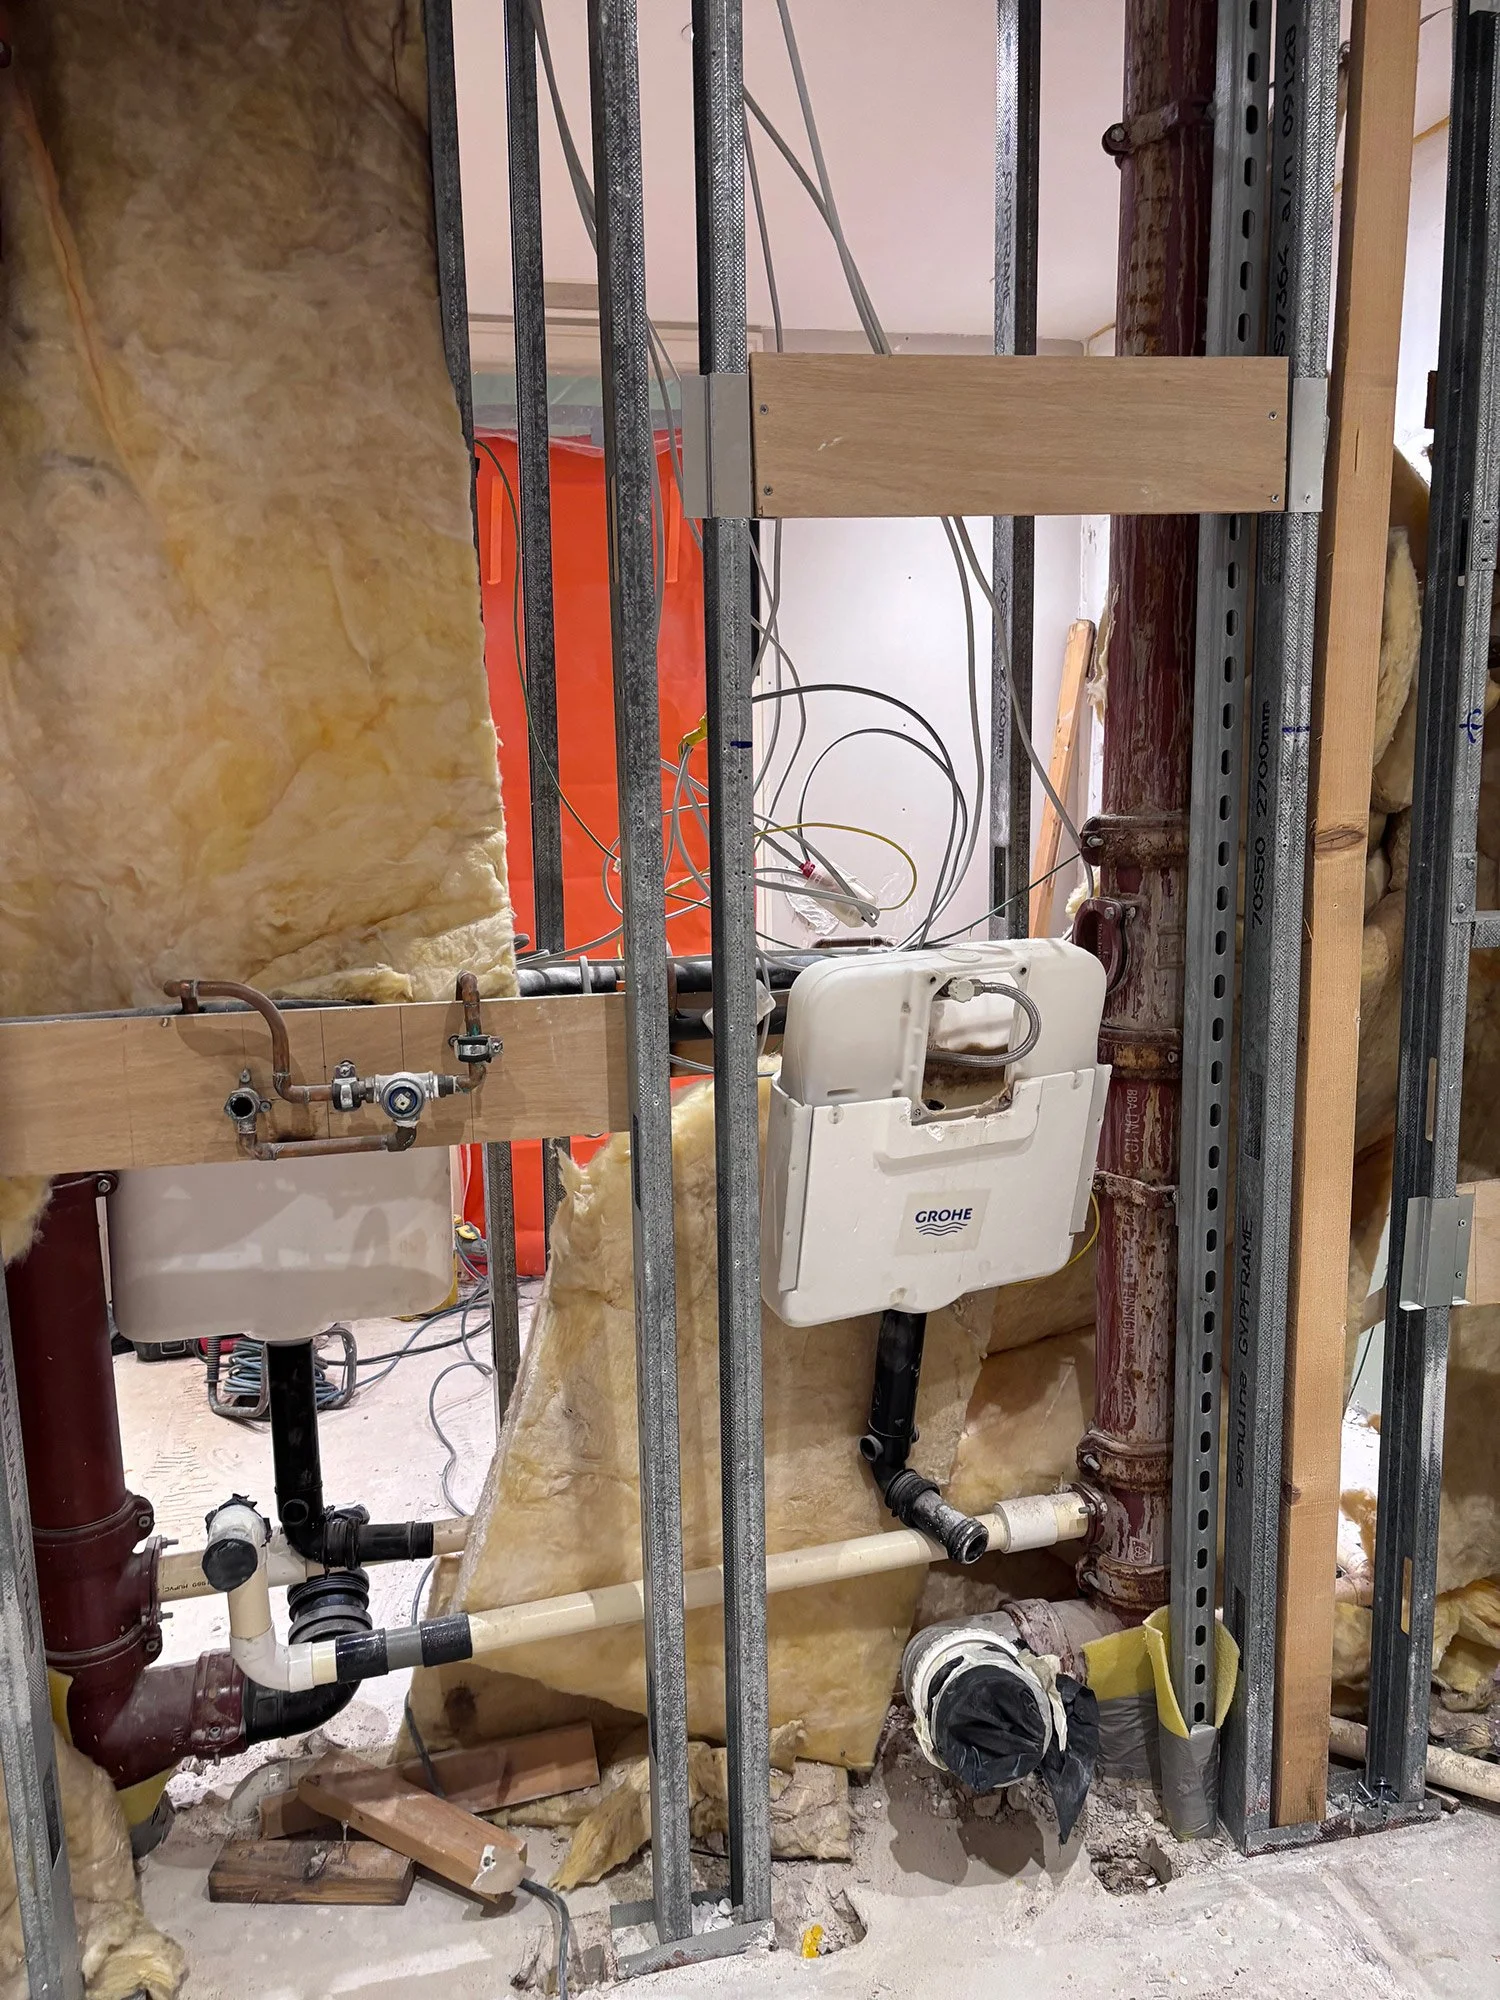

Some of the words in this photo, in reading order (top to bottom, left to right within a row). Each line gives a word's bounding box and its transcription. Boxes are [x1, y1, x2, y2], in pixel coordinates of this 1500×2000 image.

[1002, 171, 1014, 310] GYPFRAME
[1280, 155, 1293, 222] a/n
[1256, 700, 1270, 818] 2700mm
[1252, 836, 1266, 929] 70S50
[915, 1207, 973, 1224] GROHE
[1238, 1216, 1253, 1357] GYPFRAME
[1235, 1371, 1248, 1489] genuine
